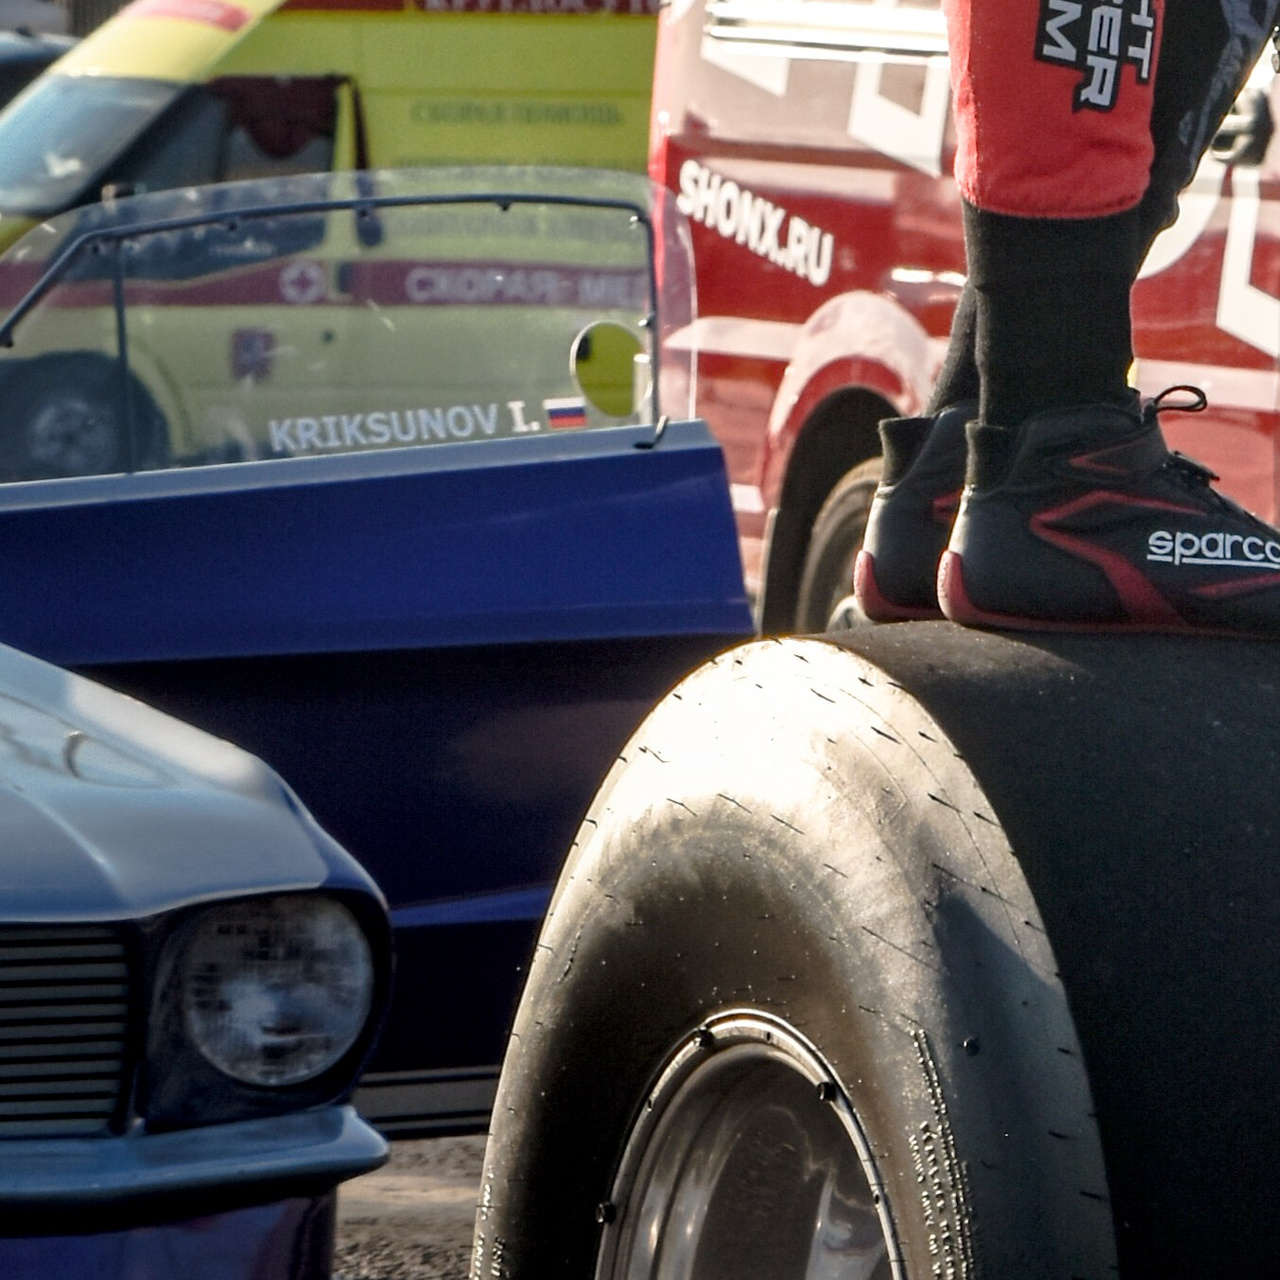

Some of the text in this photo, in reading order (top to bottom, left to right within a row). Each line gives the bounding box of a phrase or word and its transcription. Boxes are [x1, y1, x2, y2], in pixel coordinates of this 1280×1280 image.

[675, 159, 835, 287] SHONX.RU
[268, 401, 541, 452] KRIKSUNOV I.
